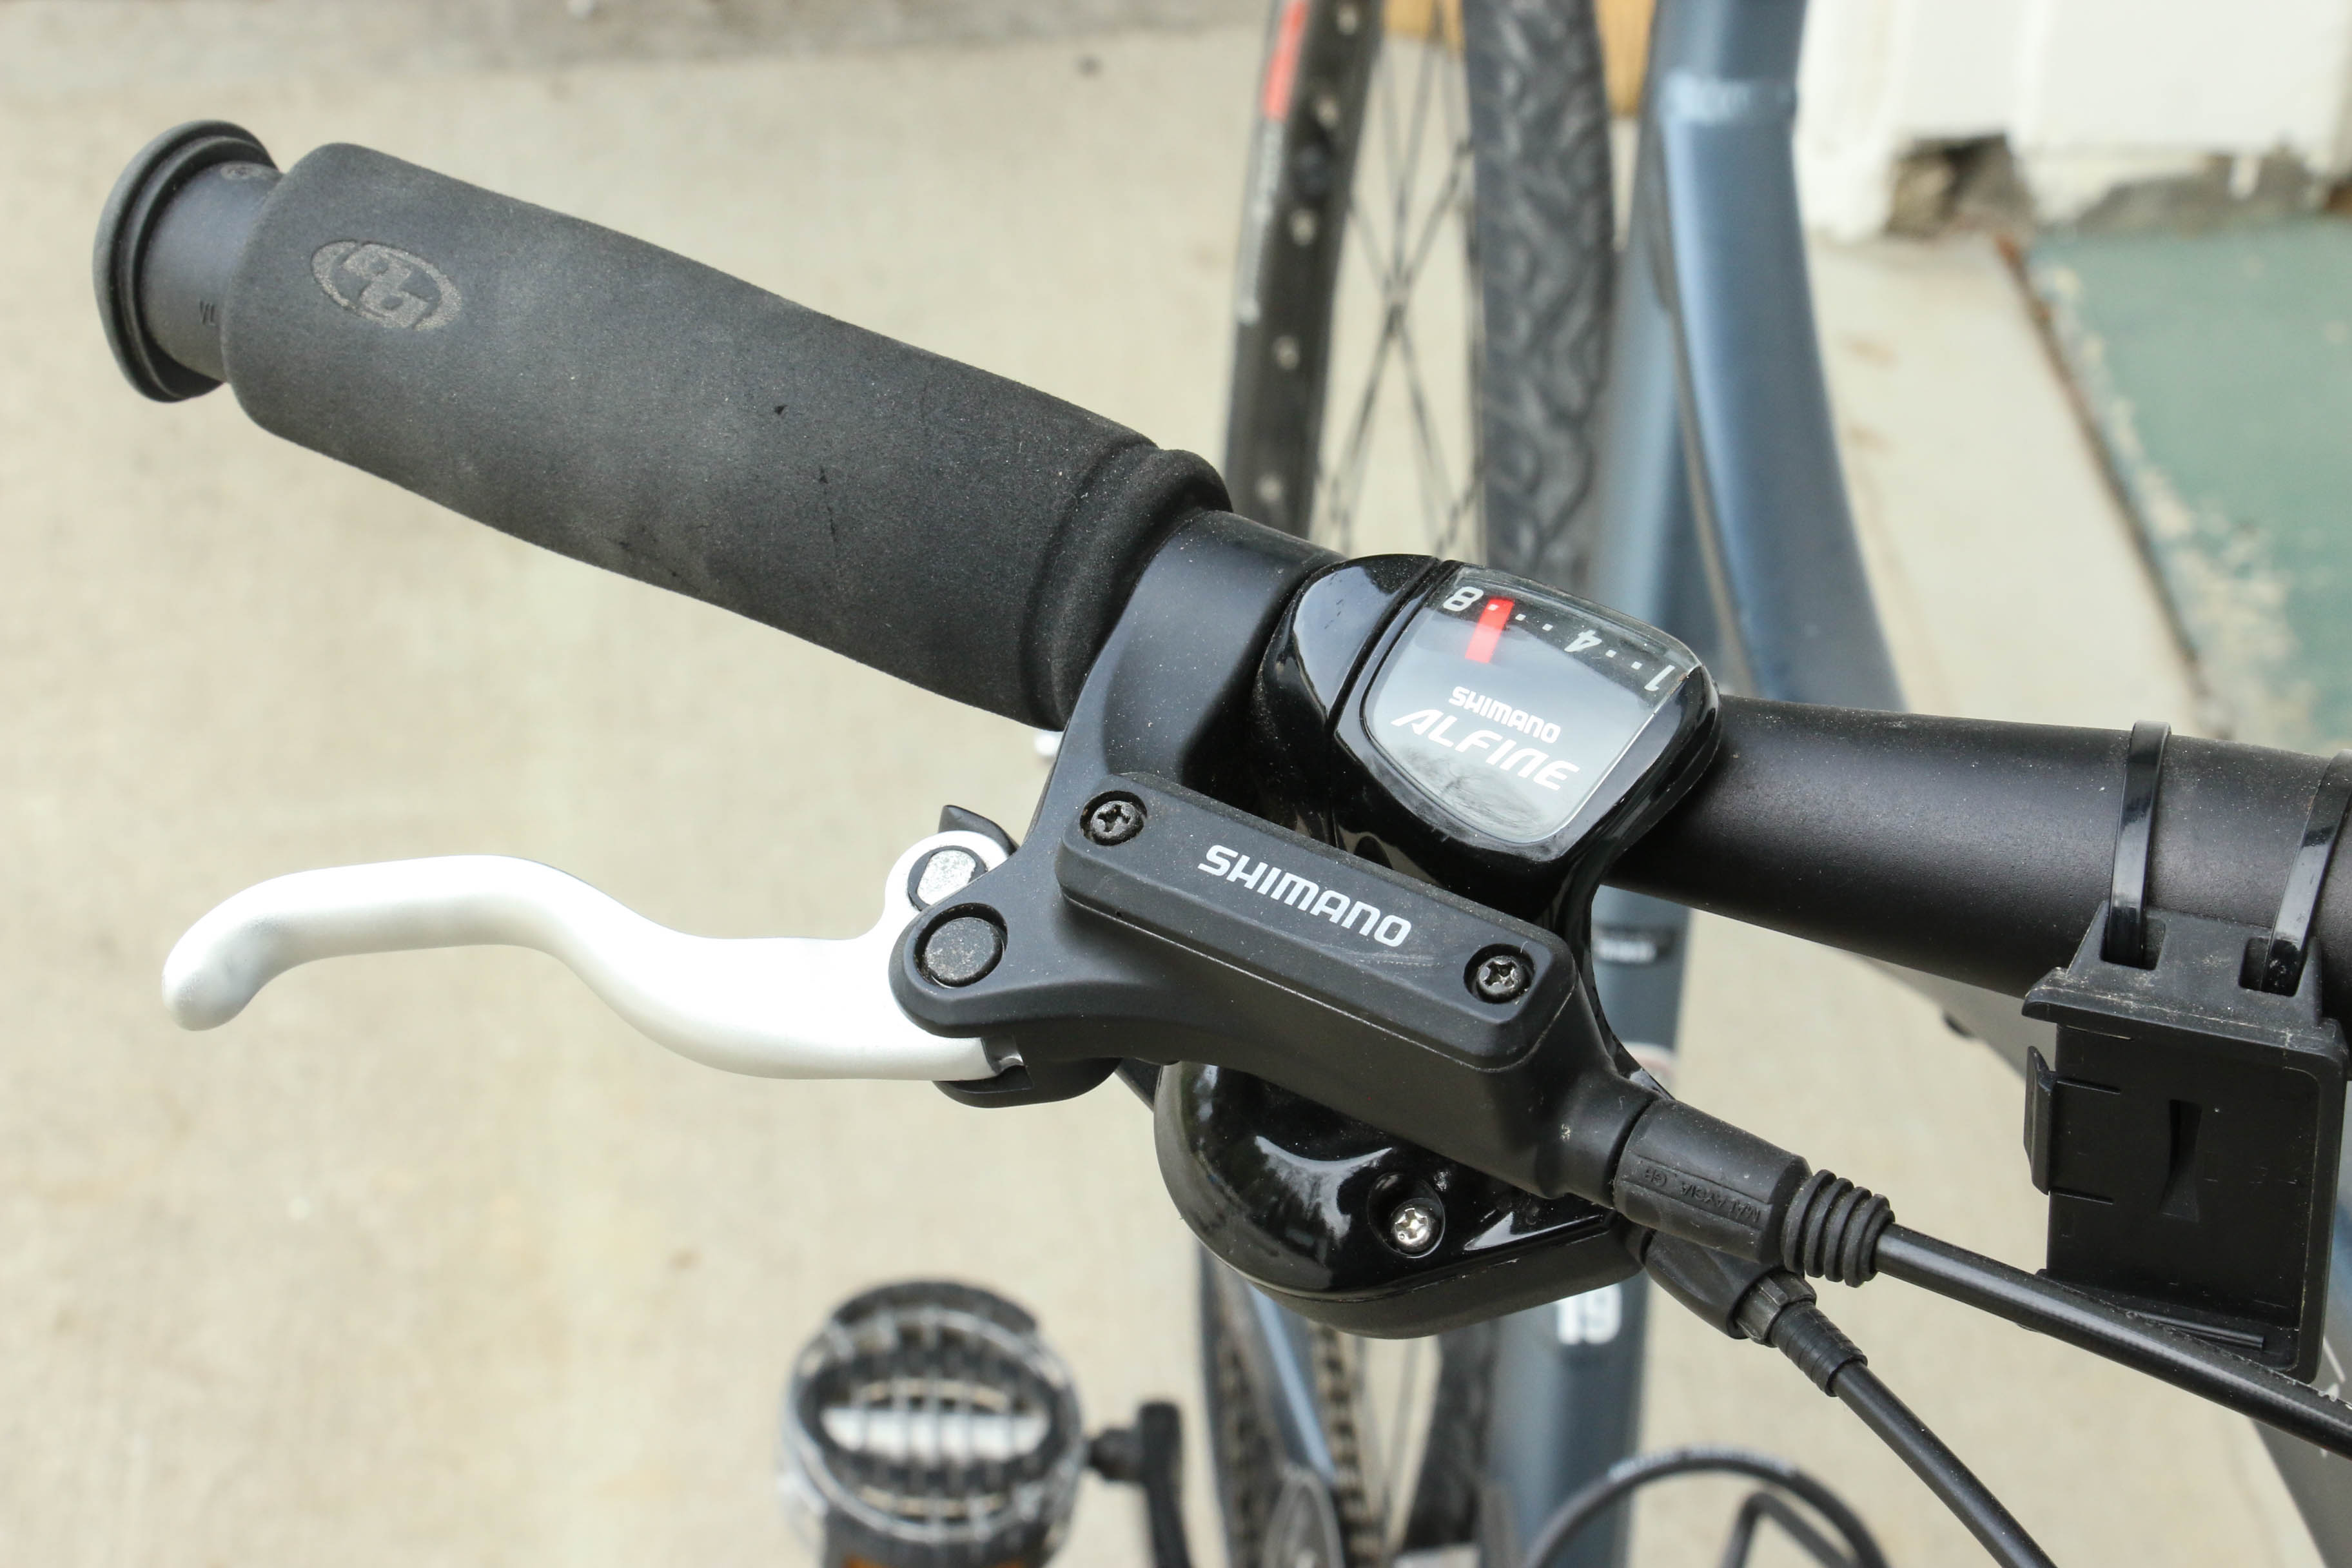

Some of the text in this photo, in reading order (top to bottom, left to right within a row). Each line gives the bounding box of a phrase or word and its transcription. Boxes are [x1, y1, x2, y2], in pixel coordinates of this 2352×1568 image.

[1442, 585, 1676, 692] 1 4 8
[1390, 709, 1581, 791] ALFINE
[1448, 685, 1562, 744] SHIMANO
[1197, 844, 1412, 948] SHIMANO
